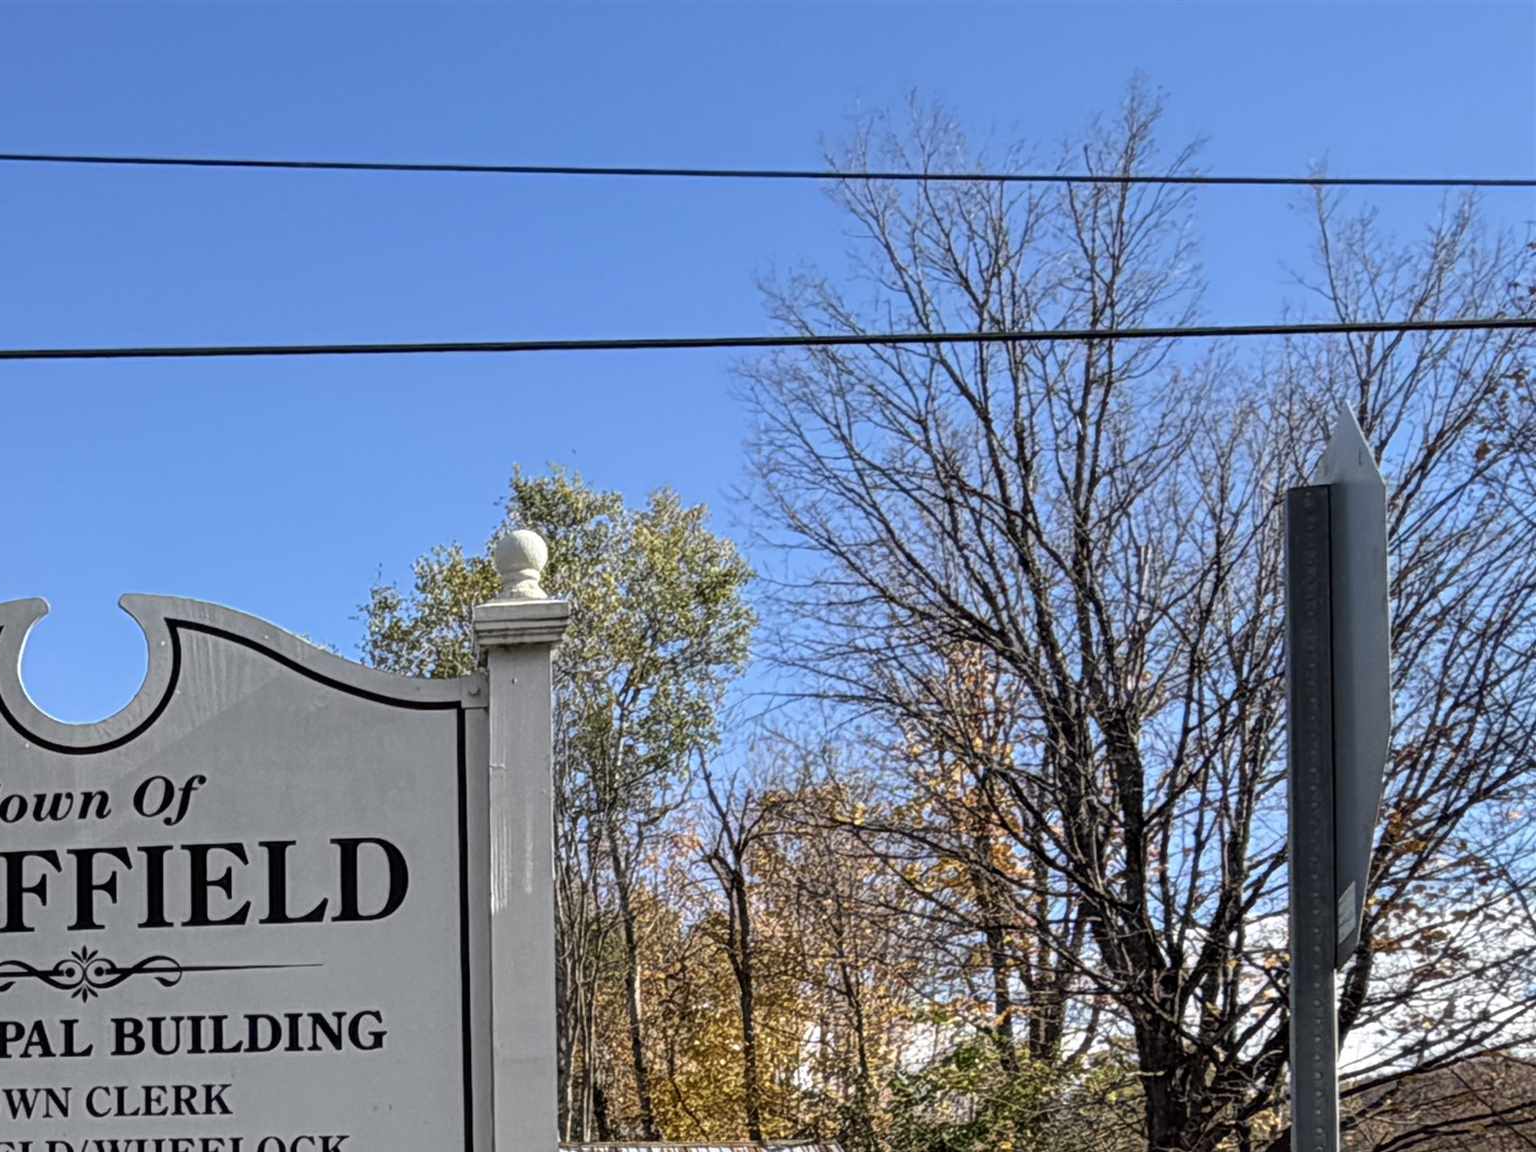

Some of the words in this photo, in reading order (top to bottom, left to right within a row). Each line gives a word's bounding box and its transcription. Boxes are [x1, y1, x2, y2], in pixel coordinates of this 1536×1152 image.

[132, 774, 207, 826] Of
[110, 1010, 388, 1056] BUILDING
[85, 1083, 233, 1118] CLERK
